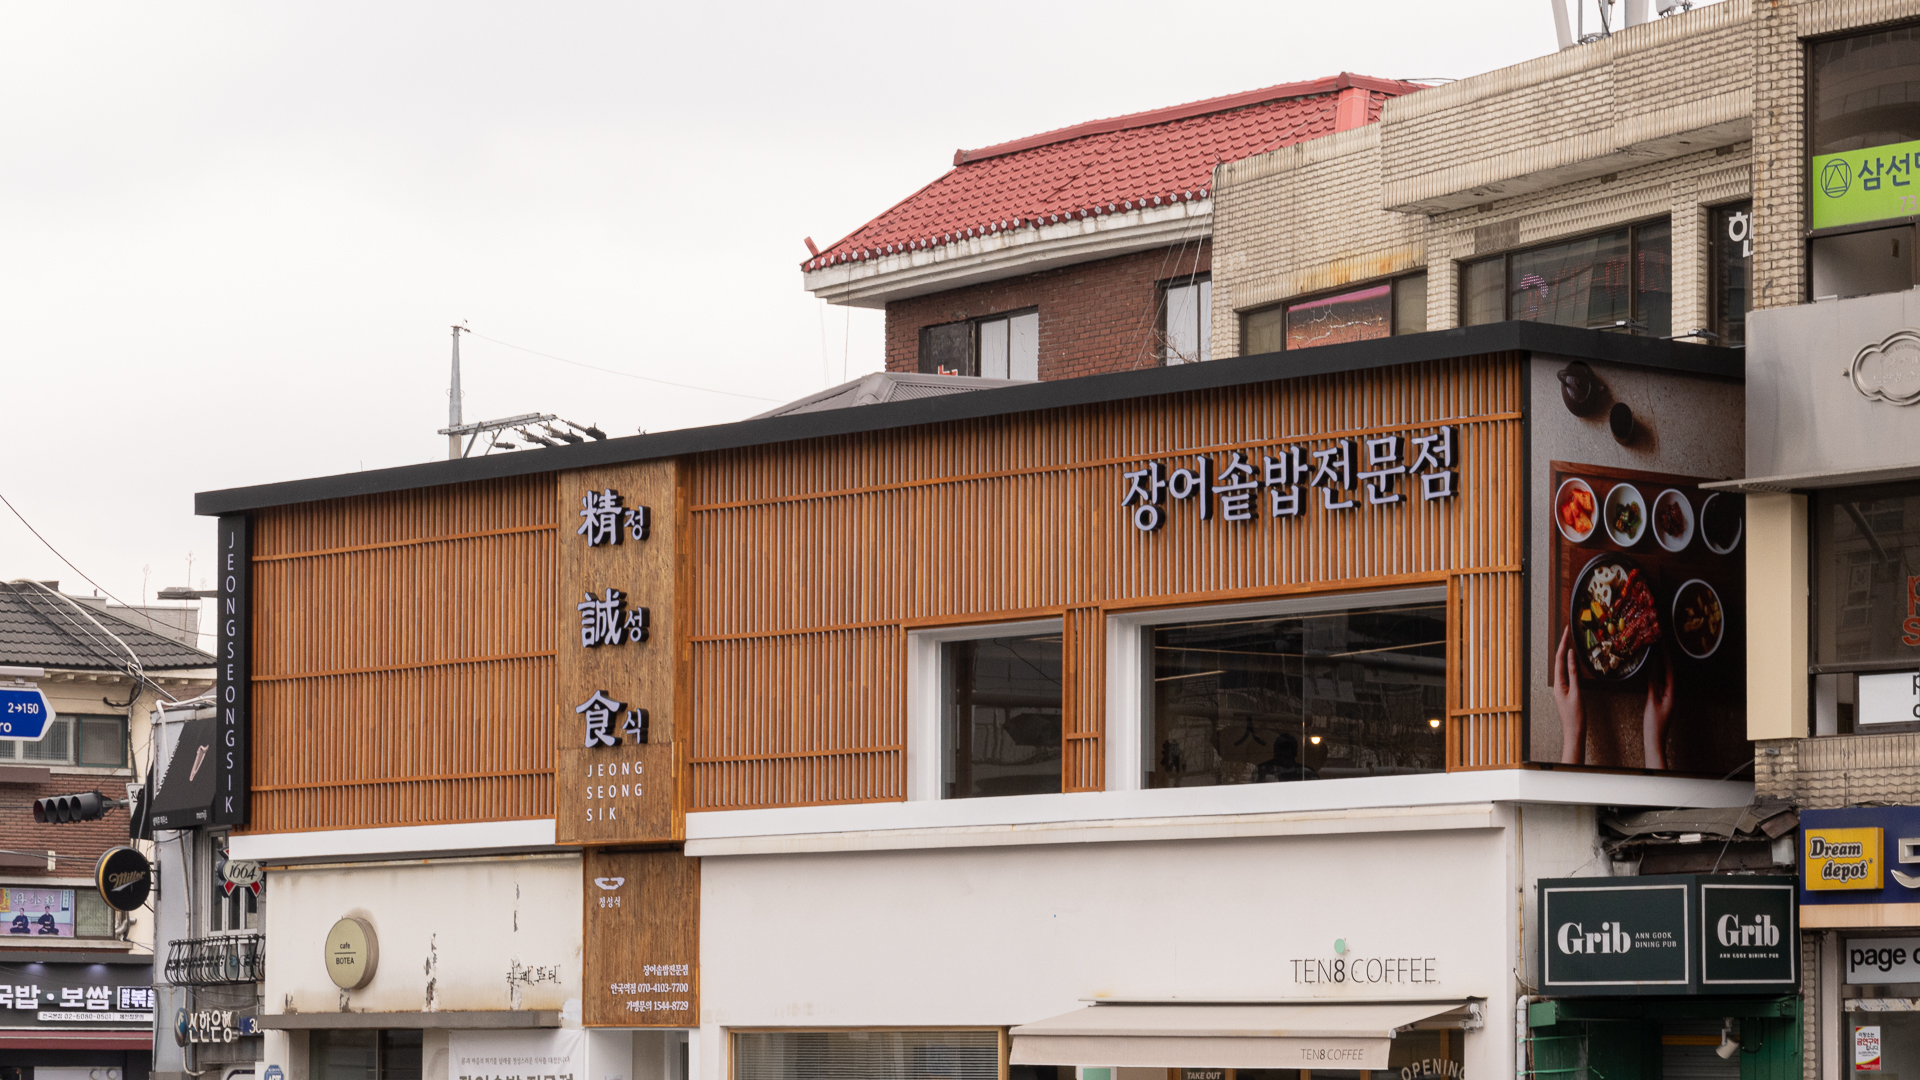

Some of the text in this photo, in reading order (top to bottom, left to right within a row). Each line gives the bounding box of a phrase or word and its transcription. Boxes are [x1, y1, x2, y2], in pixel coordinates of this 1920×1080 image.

[1899, 194, 1920, 212] 73
[1121, 426, 1455, 531] 장어솥밥전문점
[624, 505, 644, 541] 정
[624, 606, 643, 642] 성
[225, 531, 236, 813] JEONGSEONGSIK
[575, 690, 620, 748] 食
[622, 708, 643, 744] 식
[587, 761, 643, 778] JEONG
[586, 783, 643, 799] SEONG
[586, 807, 617, 822] SIK
[1810, 838, 1862, 858] Dream
[108, 870, 146, 888] Miller
[229, 863, 258, 881] 1664
[1822, 860, 1868, 883] depot
[1557, 921, 1631, 955] Grib
[1717, 914, 1780, 947] Grib
[335, 957, 355, 965] BOTEA
[1290, 958, 1436, 984] TEN8 COFFEE
[1850, 948, 1907, 973] page
[638, 983, 689, 993] 070-4103-7700
[654, 1001, 689, 1011] 1544-8729
[189, 1010, 233, 1043] 신한은행
[1301, 1049, 1364, 1060] TEN8 COFFEE
[1187, 1071, 1222, 1080] TAKE OUT
